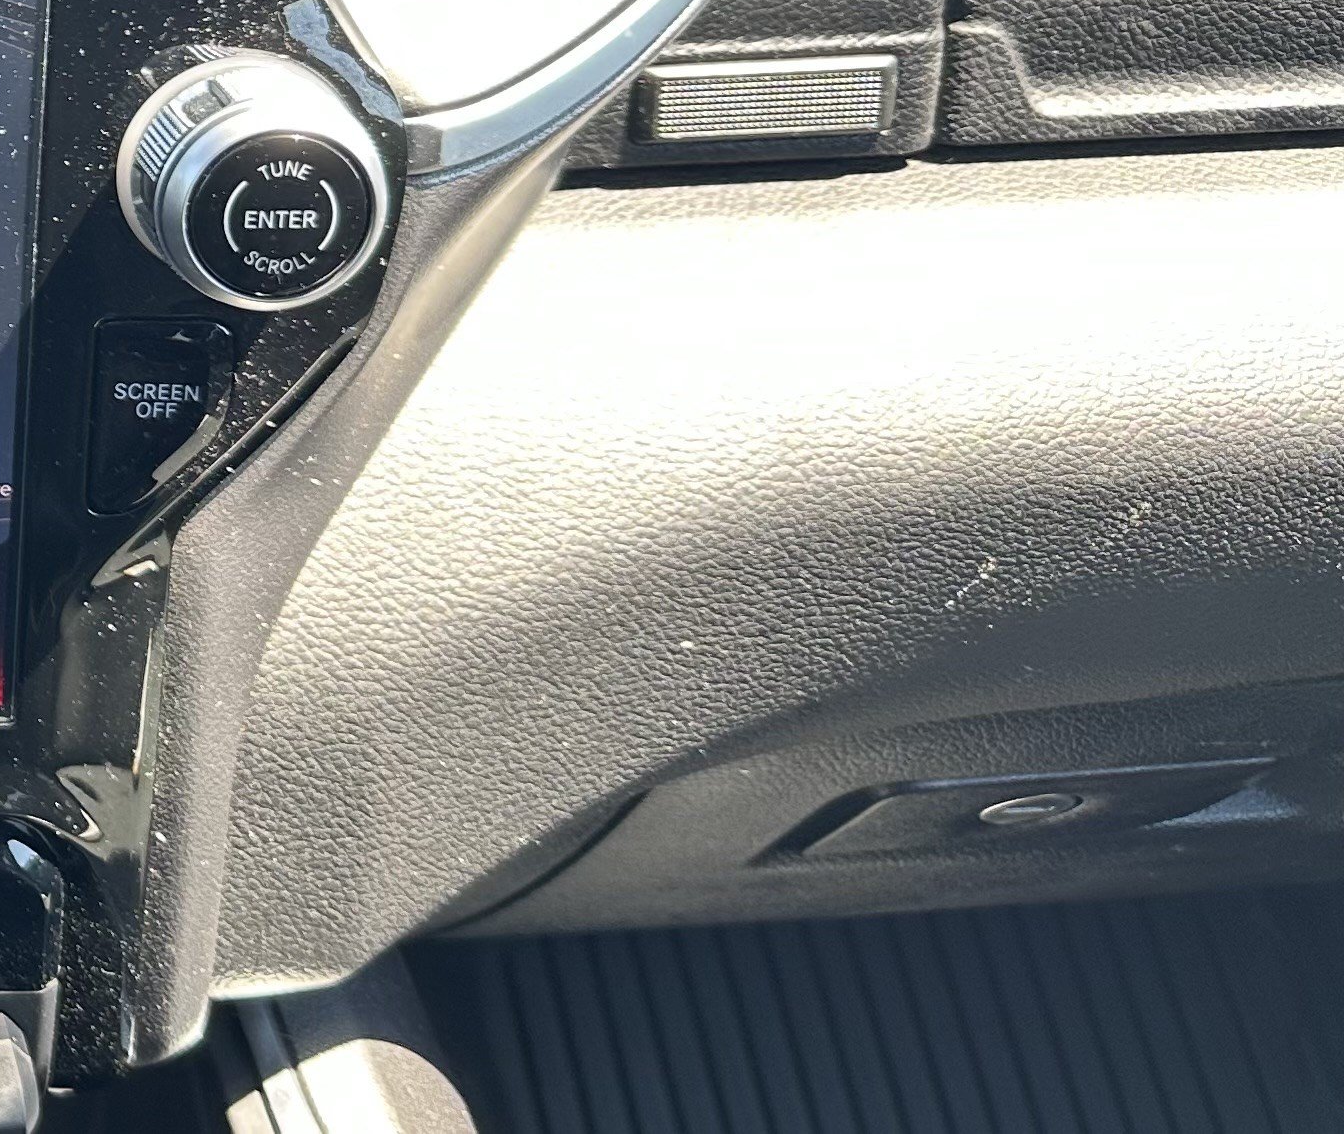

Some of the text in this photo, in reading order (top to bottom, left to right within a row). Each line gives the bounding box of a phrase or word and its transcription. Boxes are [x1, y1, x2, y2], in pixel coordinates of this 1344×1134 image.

[257, 160, 314, 182] TUNE
[244, 210, 318, 230] ENTER
[244, 250, 316, 275] SCROLL
[114, 382, 200, 403] SCREEN
[136, 402, 178, 420] OFF
